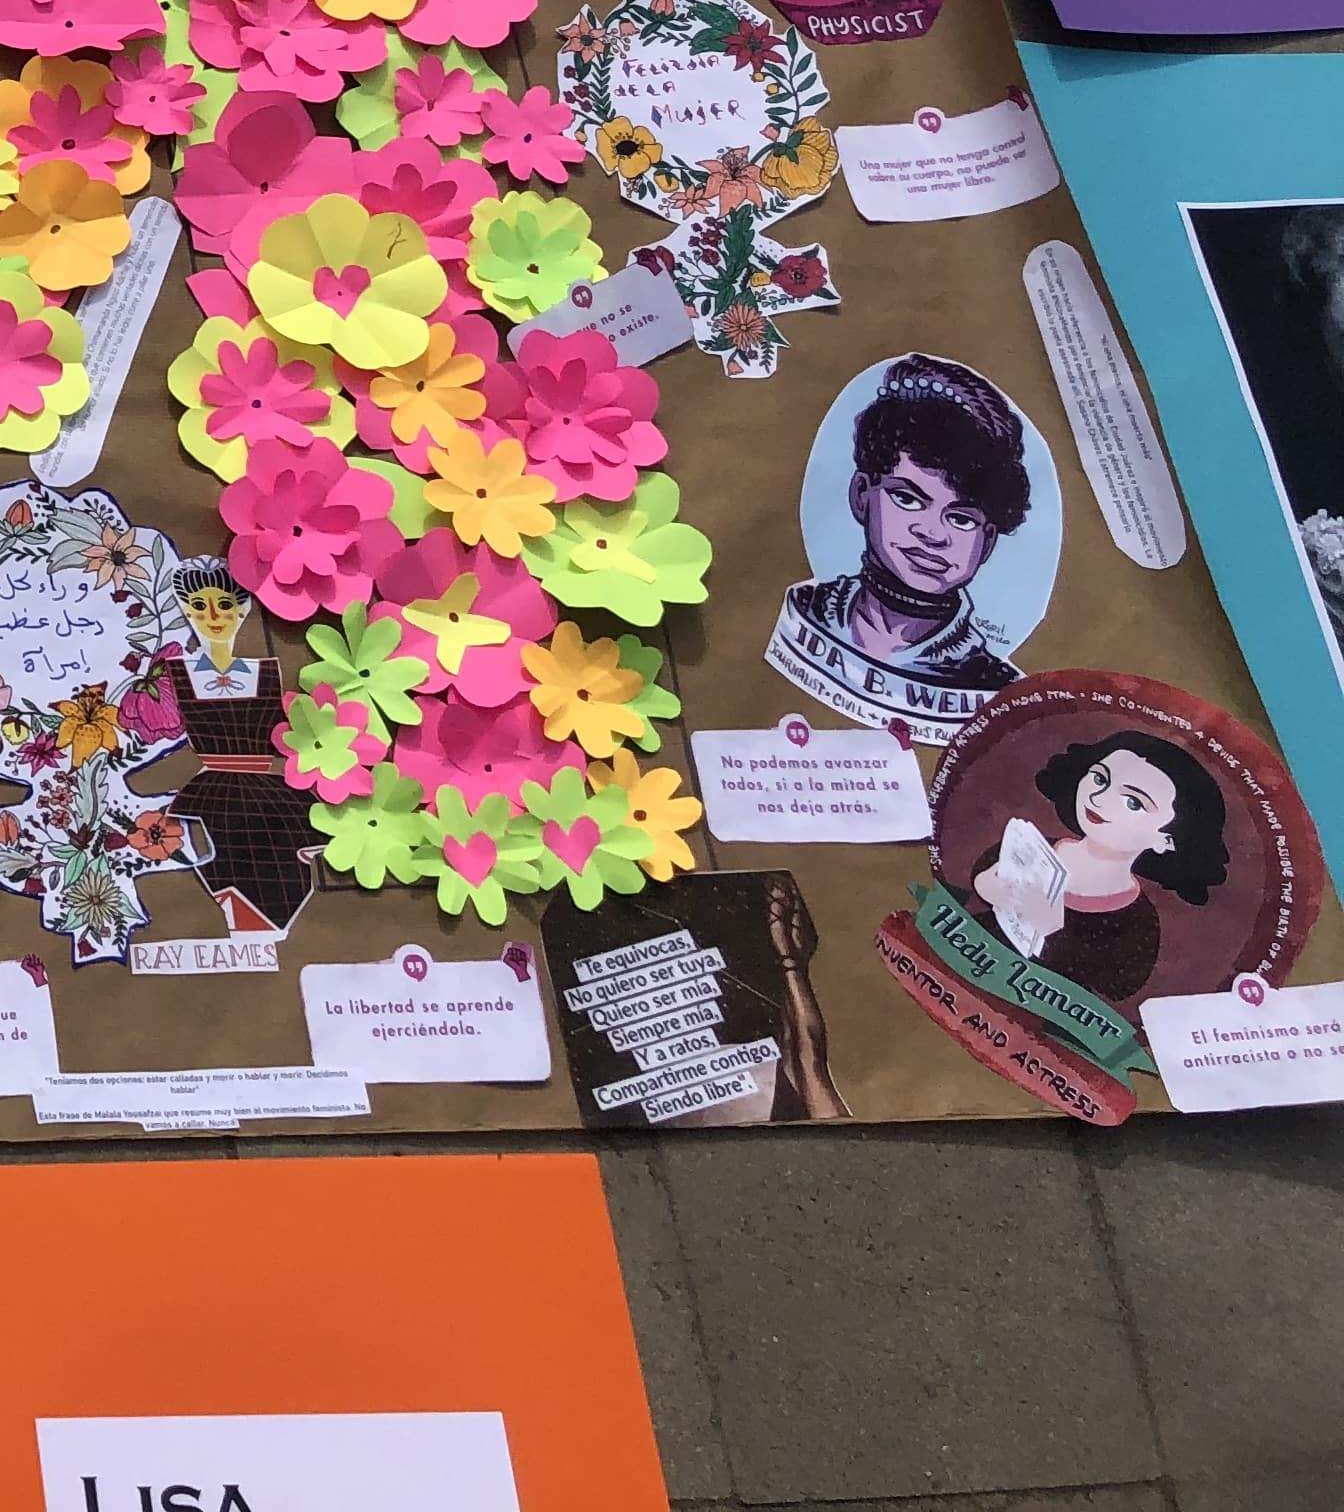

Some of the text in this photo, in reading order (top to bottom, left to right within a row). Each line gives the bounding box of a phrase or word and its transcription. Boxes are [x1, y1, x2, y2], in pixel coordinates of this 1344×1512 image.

[808, 10, 923, 36] PHYSICIST
[794, 623, 848, 676] IDA
[864, 667, 893, 697] B.
[721, 755, 887, 772] No podemos avanzar
[722, 776, 899, 792] todos, si a la mitad se
[758, 799, 877, 816] nos deja atrás.
[133, 943, 278, 970] RAY EAMES
[576, 935, 690, 977] "Te equivocas,
[570, 953, 719, 1005] No quiero ser tuya,
[931, 904, 1121, 1039] Hedy Lamarr
[326, 996, 513, 1016] La libertad se aprende
[592, 980, 717, 1028] Quiero ser mía,
[372, 1020, 480, 1040] ejerciéndola.
[613, 1007, 718, 1050] Siempre mía,
[1192, 1020, 1341, 1044] El feminismo será
[637, 1033, 715, 1064] Y a ratos,
[1184, 1050, 1296, 1068] antirracista o
[599, 1042, 777, 1105] Compartirme contigo,
[963, 1013, 1009, 1048] AND
[1014, 1048, 1101, 1119] ACTRESS
[645, 1092, 702, 1119] Siendo
